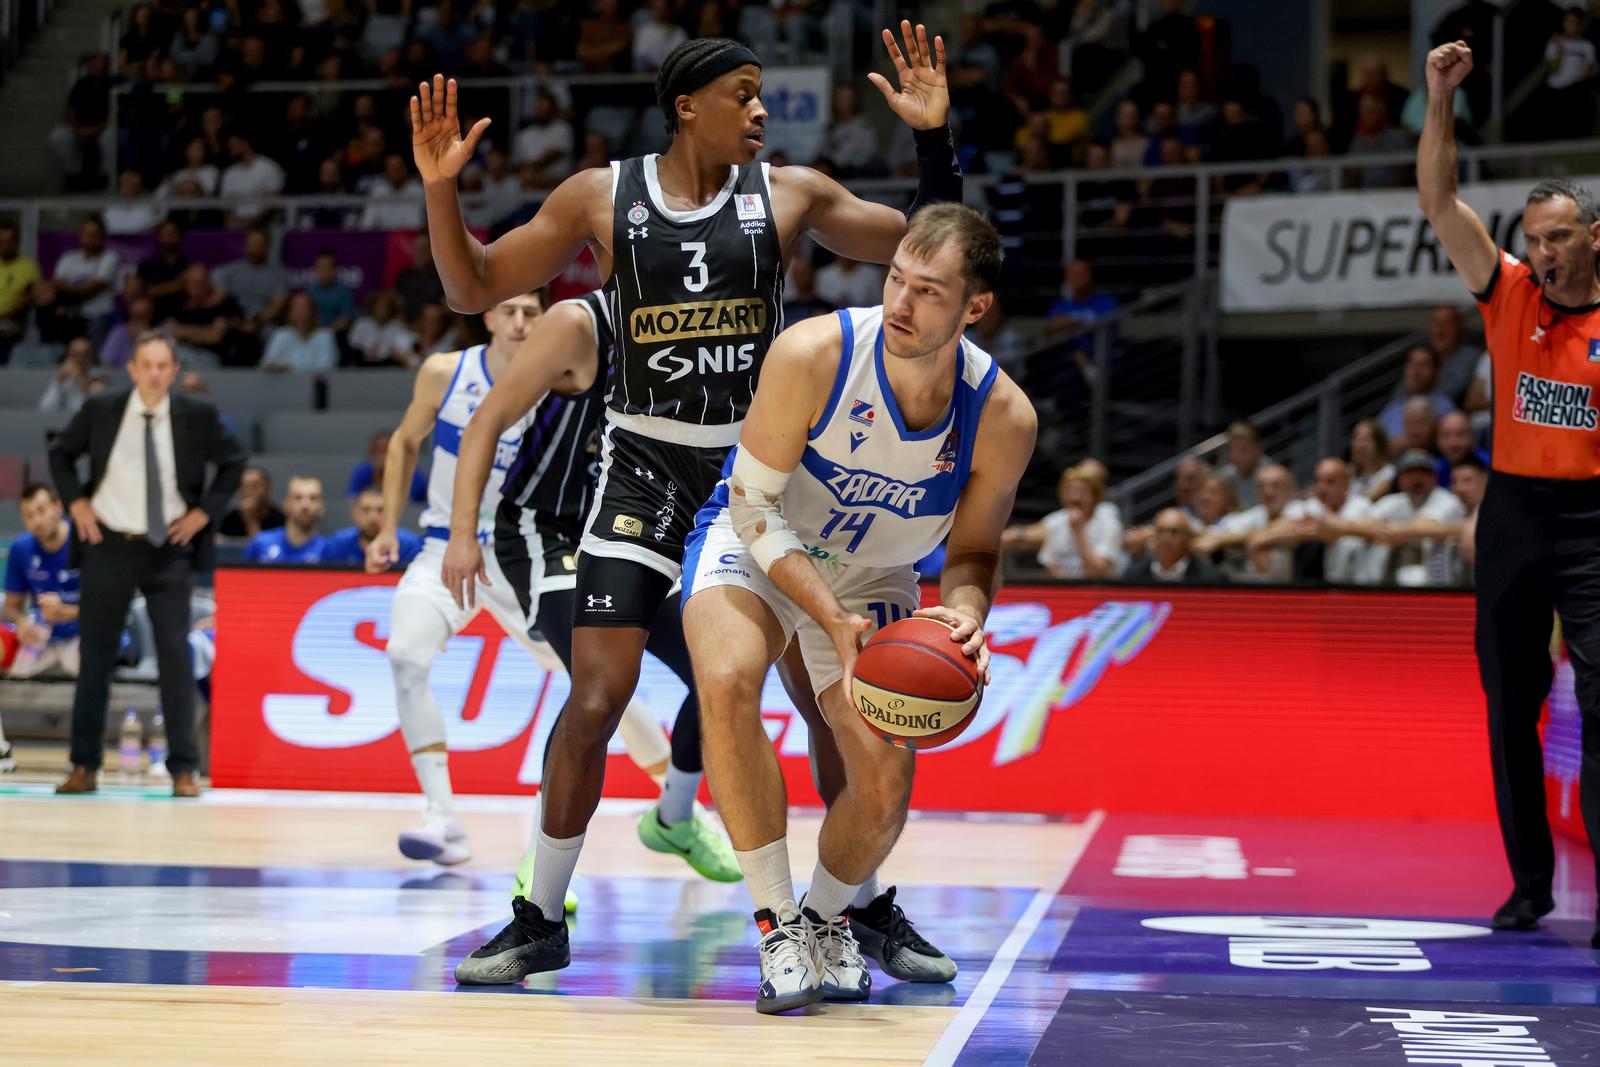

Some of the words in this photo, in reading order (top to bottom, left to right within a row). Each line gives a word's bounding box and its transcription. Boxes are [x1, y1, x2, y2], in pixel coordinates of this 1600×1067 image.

[740, 221, 766, 229] Addiko
[681, 242, 709, 292] 3
[634, 304, 763, 338] MOZZART
[698, 343, 755, 375] NIS
[1517, 373, 1590, 408] FASHION
[826, 466, 927, 516] ZADAR
[614, 526, 639, 537] MOZZART
[819, 507, 877, 554] 14
[704, 567, 751, 578] cromaris
[861, 695, 941, 730] SPALDING
